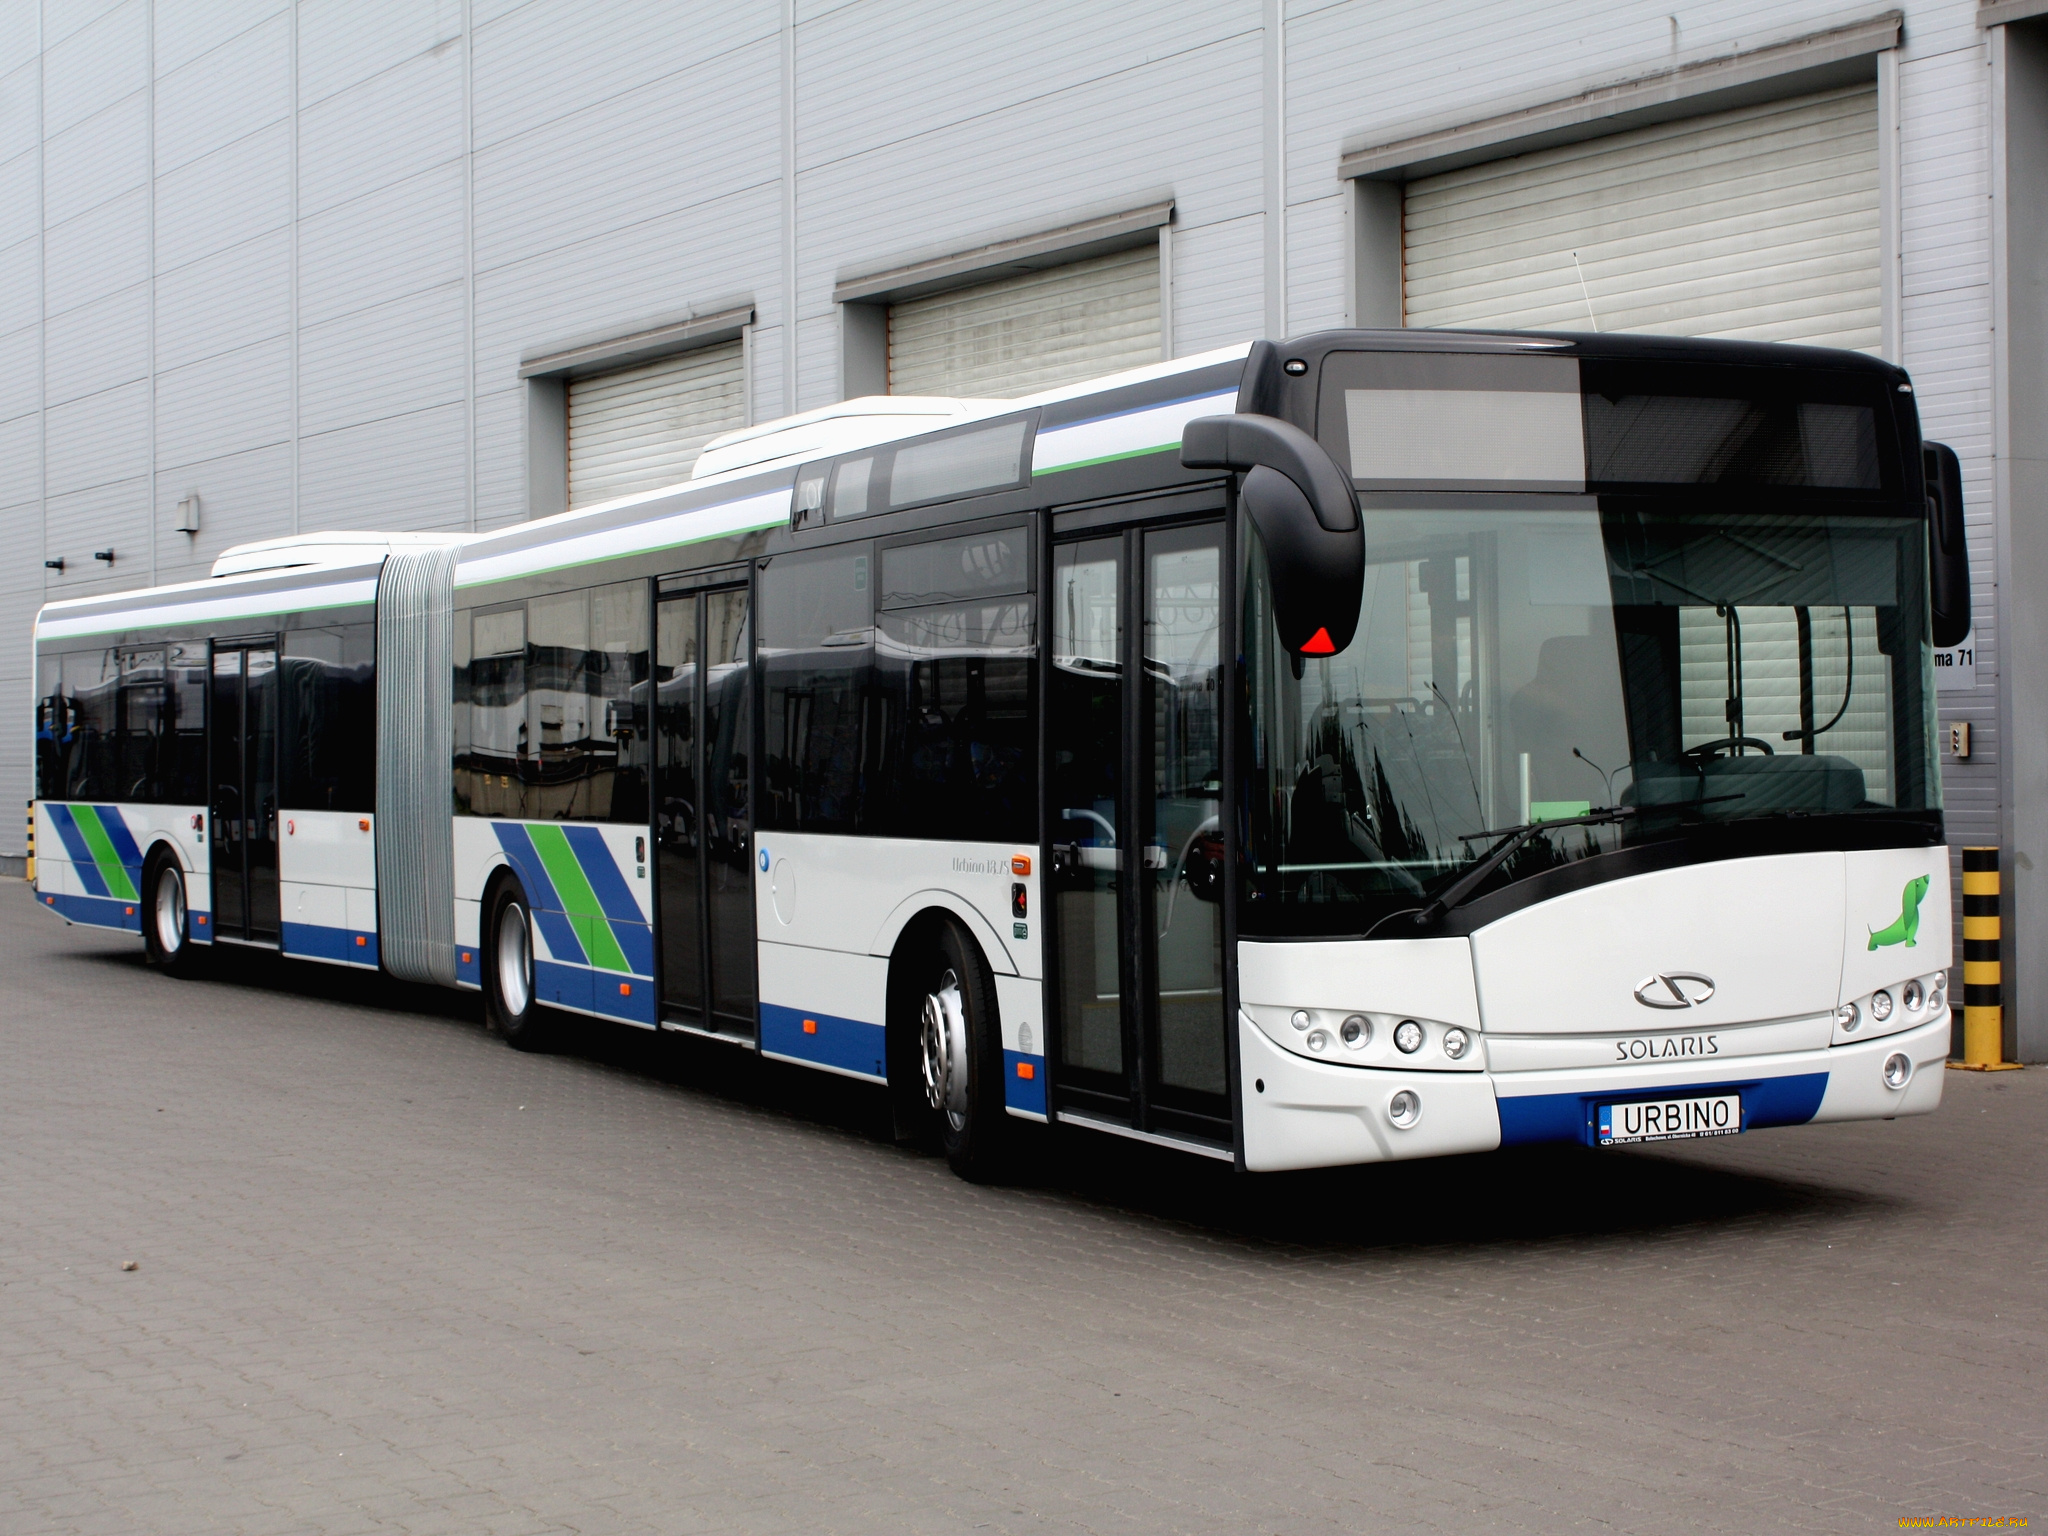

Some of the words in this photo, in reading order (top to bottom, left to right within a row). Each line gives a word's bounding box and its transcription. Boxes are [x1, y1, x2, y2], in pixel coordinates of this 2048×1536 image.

[1958, 649, 1972, 666] 71
[952, 857, 985, 873] Urbino
[1616, 1035, 1719, 1061] SOLARIS
[1624, 1100, 1729, 1135] URBINO
[1614, 1136, 1642, 1145] SOLARIS
